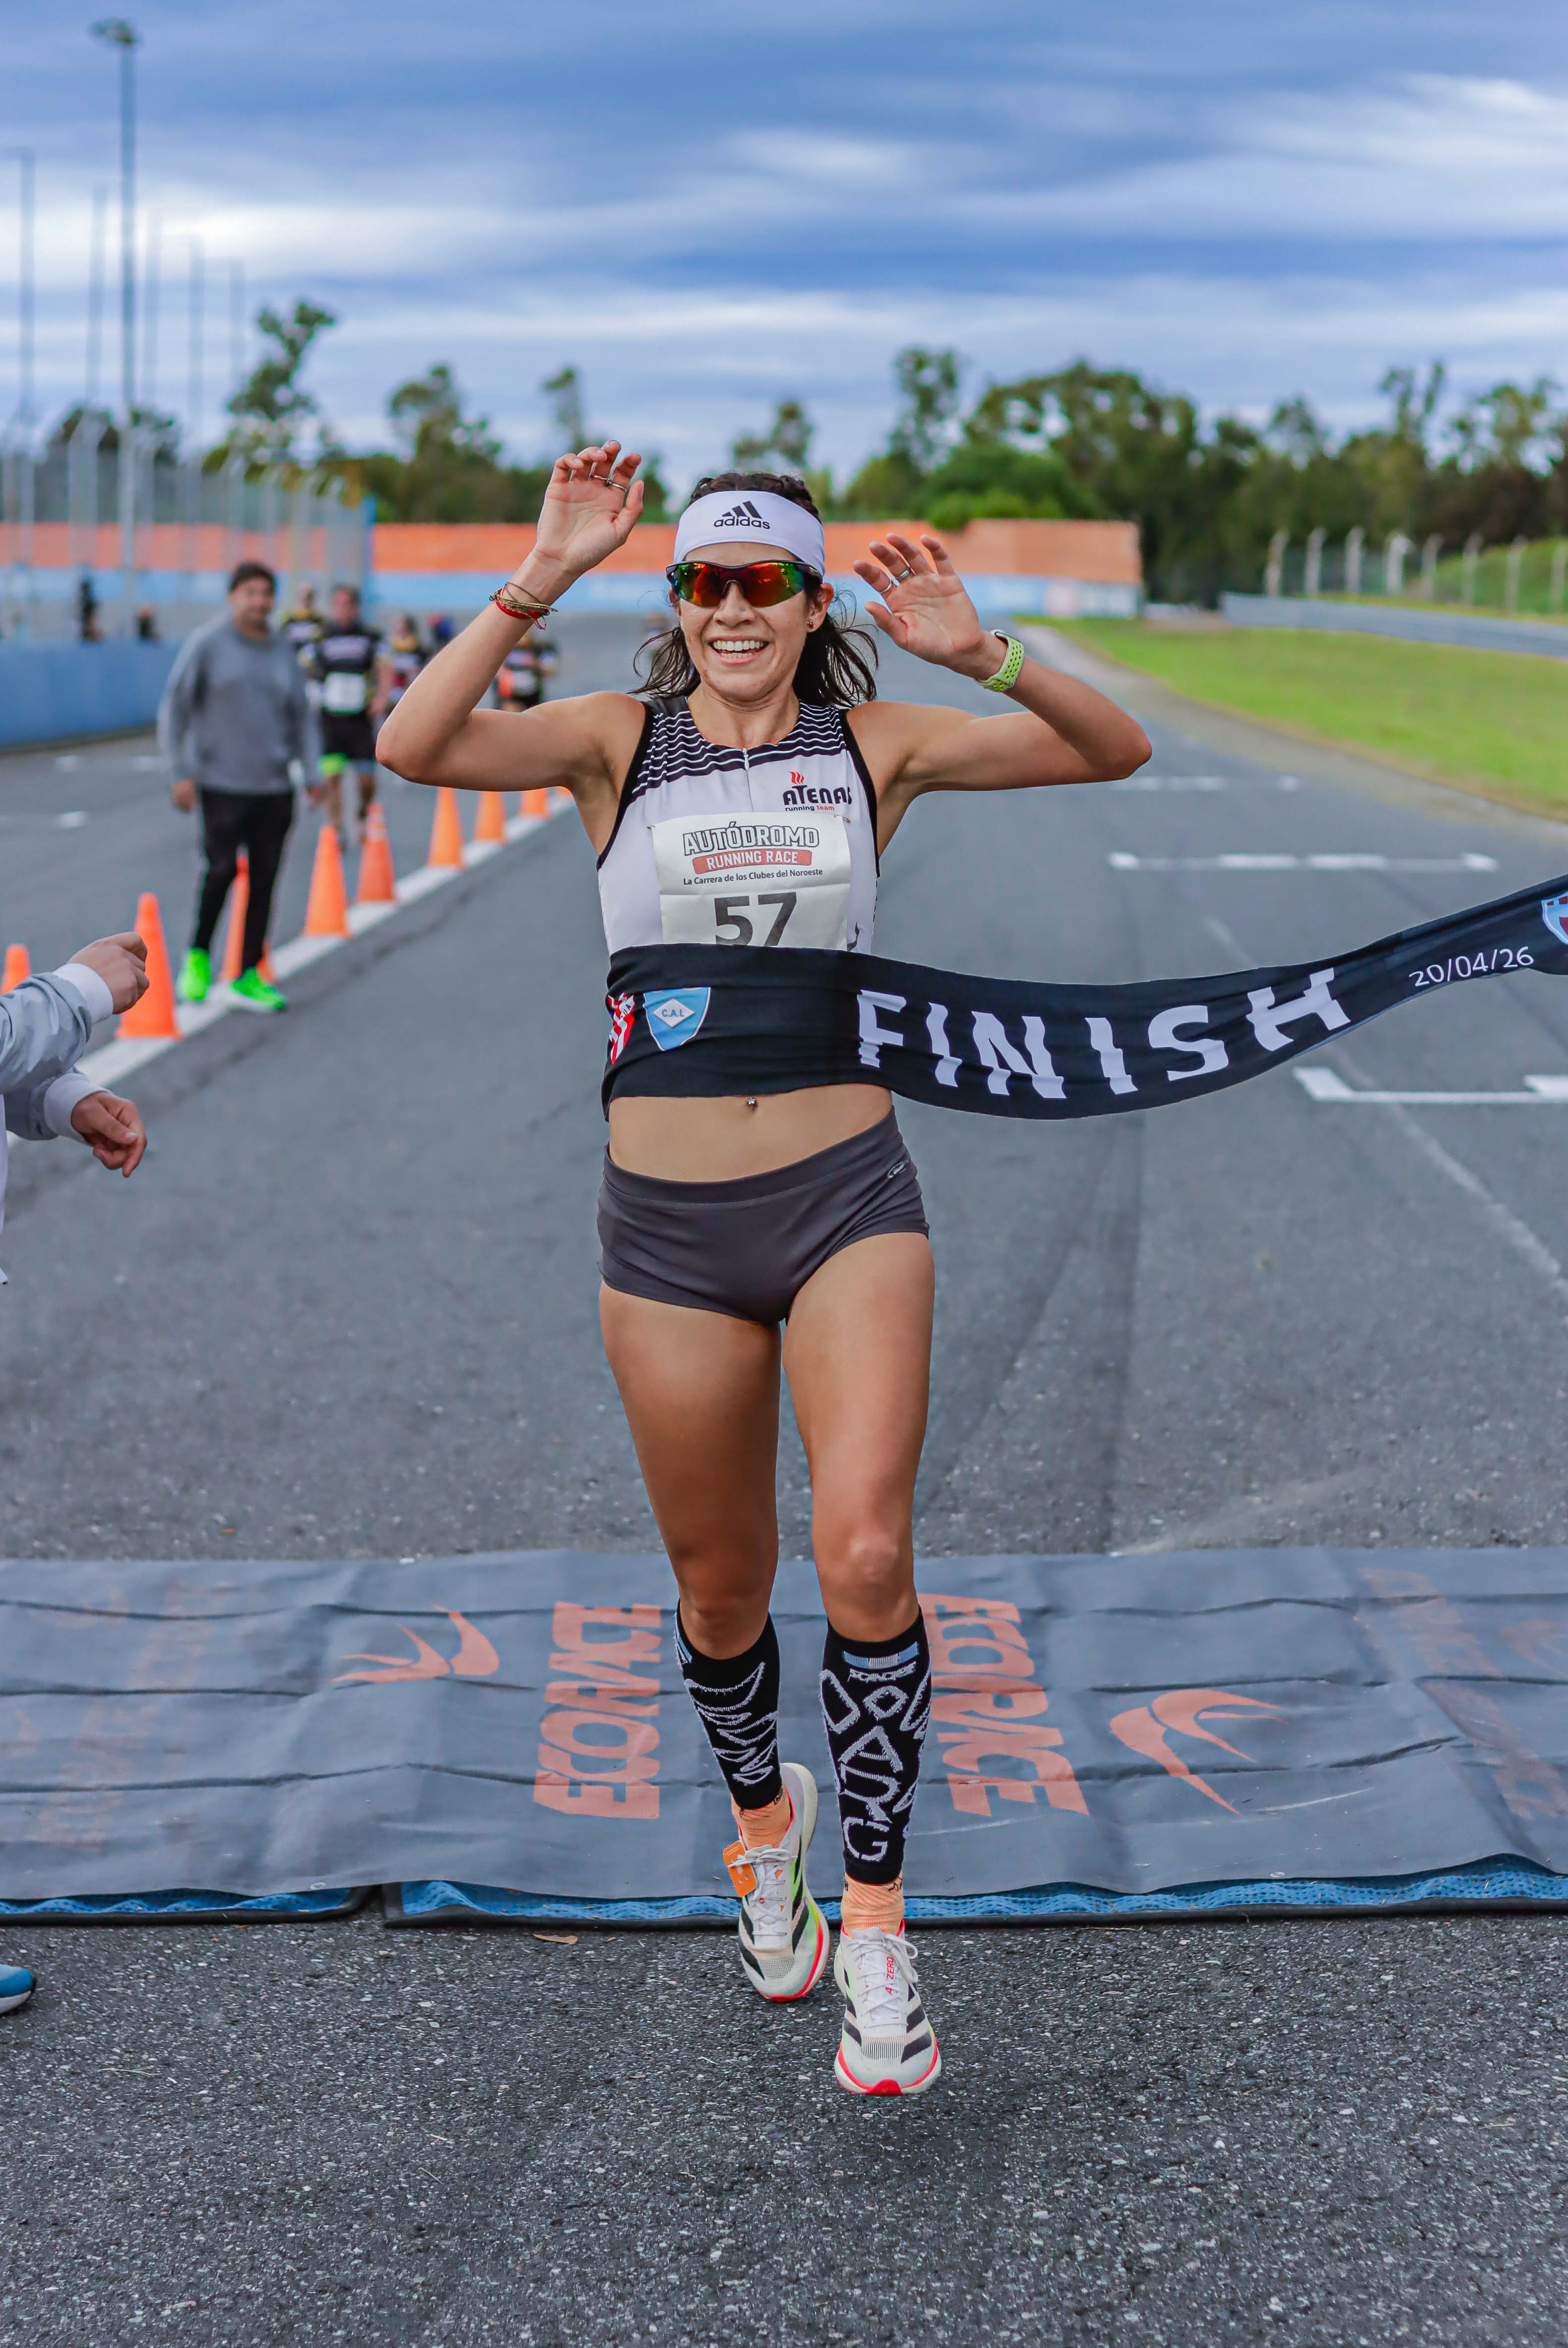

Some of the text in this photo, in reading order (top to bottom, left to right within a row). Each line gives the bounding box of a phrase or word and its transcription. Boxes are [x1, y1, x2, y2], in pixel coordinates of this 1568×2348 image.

[714, 516, 770, 529] adidas
[683, 821, 819, 856] AUTÓDROMO
[694, 875, 723, 884] Carrera
[724, 873, 734, 881] de
[736, 871, 747, 880] los
[749, 869, 775, 879] Clubes
[777, 868, 788, 878] del
[790, 868, 823, 877] Noroeste
[706, 849, 798, 870] RUNNING RACE
[714, 892, 797, 946] 57
[1409, 946, 1534, 987] 20/04/26
[857, 968, 1351, 1099] FINISH
[533, 1601, 661, 1819] ECORACE
[885, 1956, 895, 1995] AZERO
